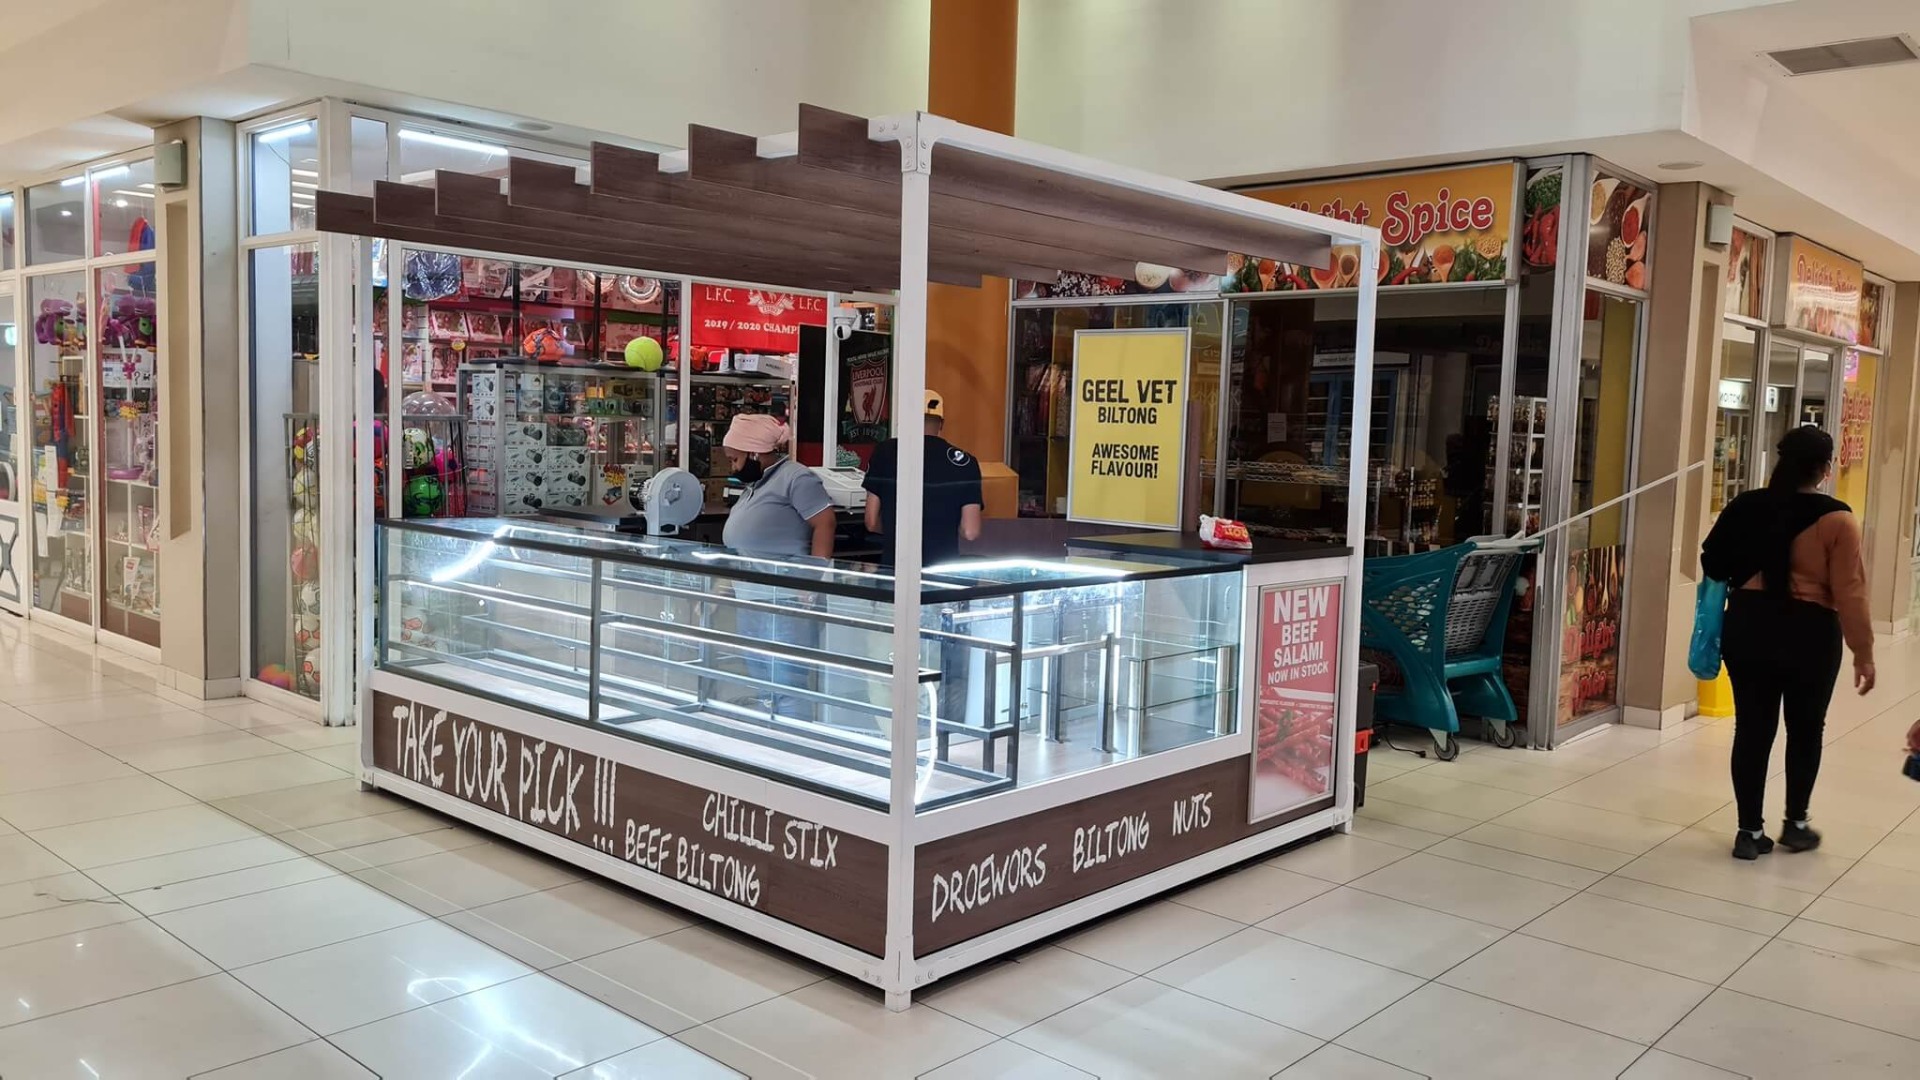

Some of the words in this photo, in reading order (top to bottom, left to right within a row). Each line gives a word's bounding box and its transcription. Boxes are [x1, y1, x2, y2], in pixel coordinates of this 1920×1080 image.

[1381, 187, 1494, 246] Spice
[706, 286, 735, 303] L.F.C.
[799, 297, 822, 312] L.F.C.
[704, 319, 728, 330] 2019
[729, 320, 736, 330] /
[737, 321, 761, 331] 2020
[853, 367, 884, 380] LIVERPOOL
[1082, 379, 1130, 403] GEEL
[1137, 379, 1178, 404] VET
[1098, 406, 1158, 424] BILTONG
[1092, 443, 1160, 461] AWESOME
[1091, 460, 1158, 479] FLAVOUR!
[1273, 586, 1331, 624] NEW
[1281, 619, 1319, 647] BEEF
[1273, 640, 1325, 669] SALAMI
[1267, 669, 1288, 686] NOW
[1290, 667, 1300, 680] IN
[1301, 660, 1330, 679] STOCK
[392, 701, 447, 788] TAKE
[453, 720, 510, 816] YOUR
[519, 738, 585, 835] PICK
[592, 755, 617, 855] !!!
[703, 792, 775, 852] CHILLI
[783, 819, 839, 870] STIX
[625, 819, 673, 874] BEEF
[676, 836, 761, 907] BILTONG
[931, 844, 1048, 923] DROEWORS
[1072, 811, 1150, 874] BILTONG
[1172, 792, 1213, 837] NUTS
